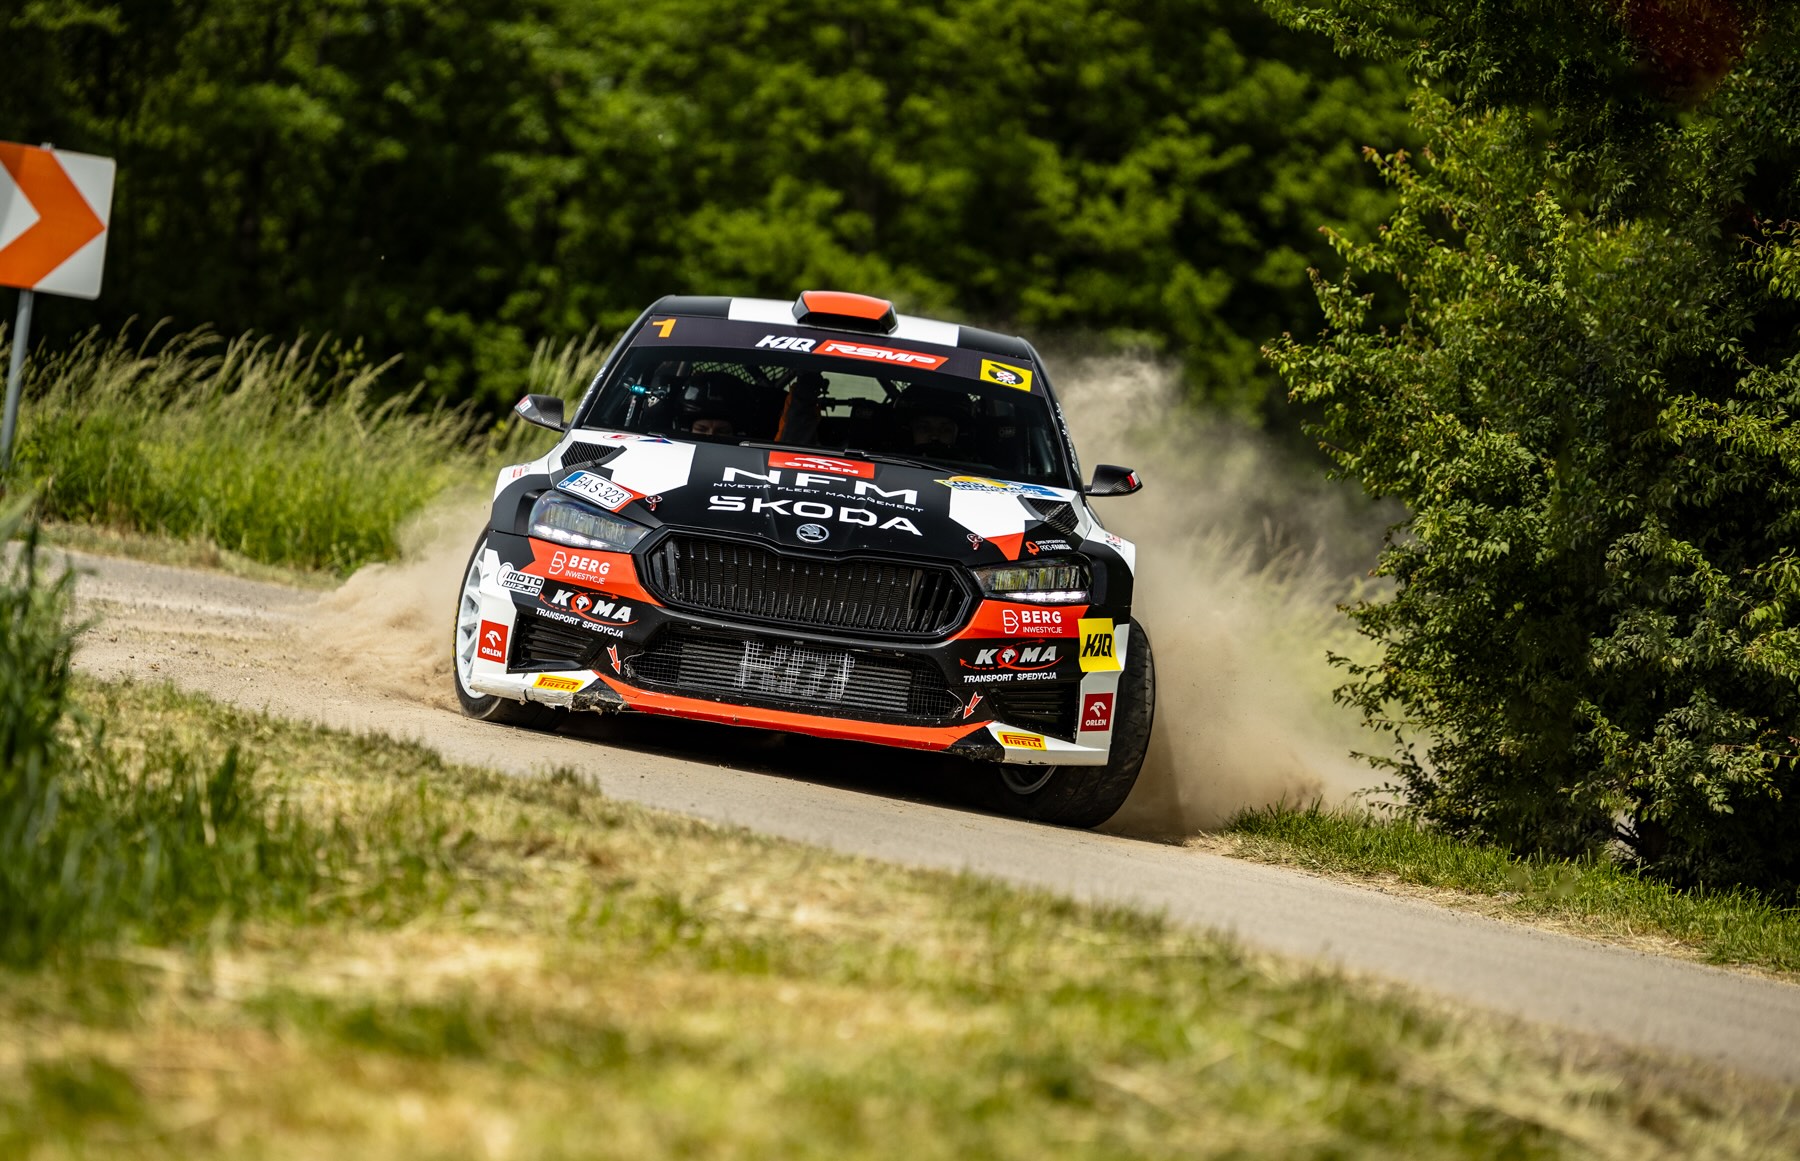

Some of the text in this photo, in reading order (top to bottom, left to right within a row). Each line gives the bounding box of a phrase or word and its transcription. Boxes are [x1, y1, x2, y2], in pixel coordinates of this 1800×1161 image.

[653, 319, 676, 337] 1
[825, 343, 936, 363] RSMP
[784, 462, 859, 474] ORLEN
[573, 477, 625, 503] BA S 323
[722, 467, 918, 505] NFM
[777, 486, 820, 494] FLEET
[826, 491, 924, 512] MANAGEMENT
[707, 495, 923, 536] SKODA
[569, 555, 611, 575] BERG
[506, 571, 544, 586] MOTO
[565, 570, 606, 585] INWESTYCJE
[503, 581, 540, 595] WIZJA
[536, 608, 624, 638] TRANSPORT SPEDYCJA
[1021, 611, 1062, 624] BERG
[1022, 626, 1062, 634] INWESTYCJE
[481, 646, 502, 658] ORLEN
[538, 675, 579, 690] PIRELLI
[963, 672, 1057, 683] TRANSPORT SPEDYCJA
[1085, 719, 1107, 727] ORLEN
[1003, 734, 1042, 748] PIRELLI
